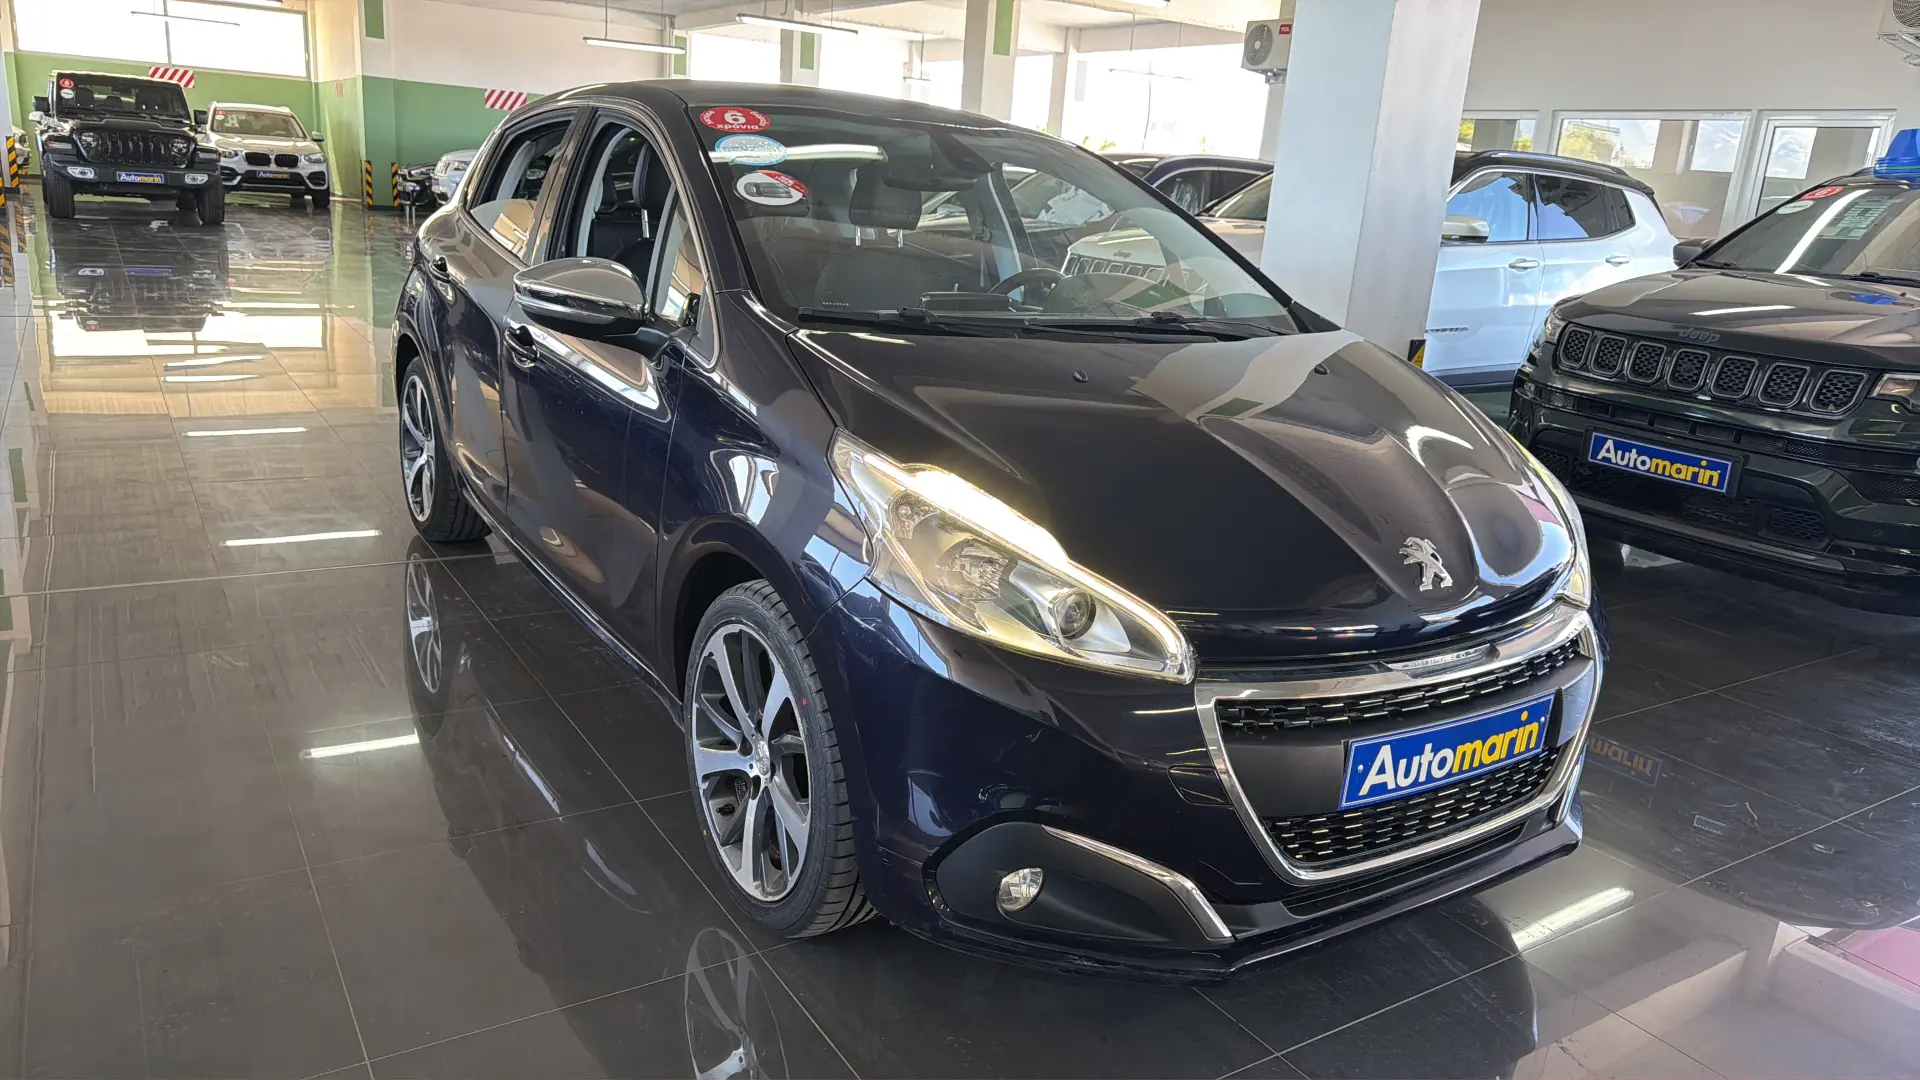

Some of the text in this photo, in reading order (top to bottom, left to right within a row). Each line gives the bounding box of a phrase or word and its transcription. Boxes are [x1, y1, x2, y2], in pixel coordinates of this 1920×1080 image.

[724, 111, 746, 124] 6
[120, 173, 162, 183] Automarin
[1678, 327, 1721, 344] Jeep
[1597, 439, 1720, 487] Automarin
[1358, 711, 1539, 796] Automarin
